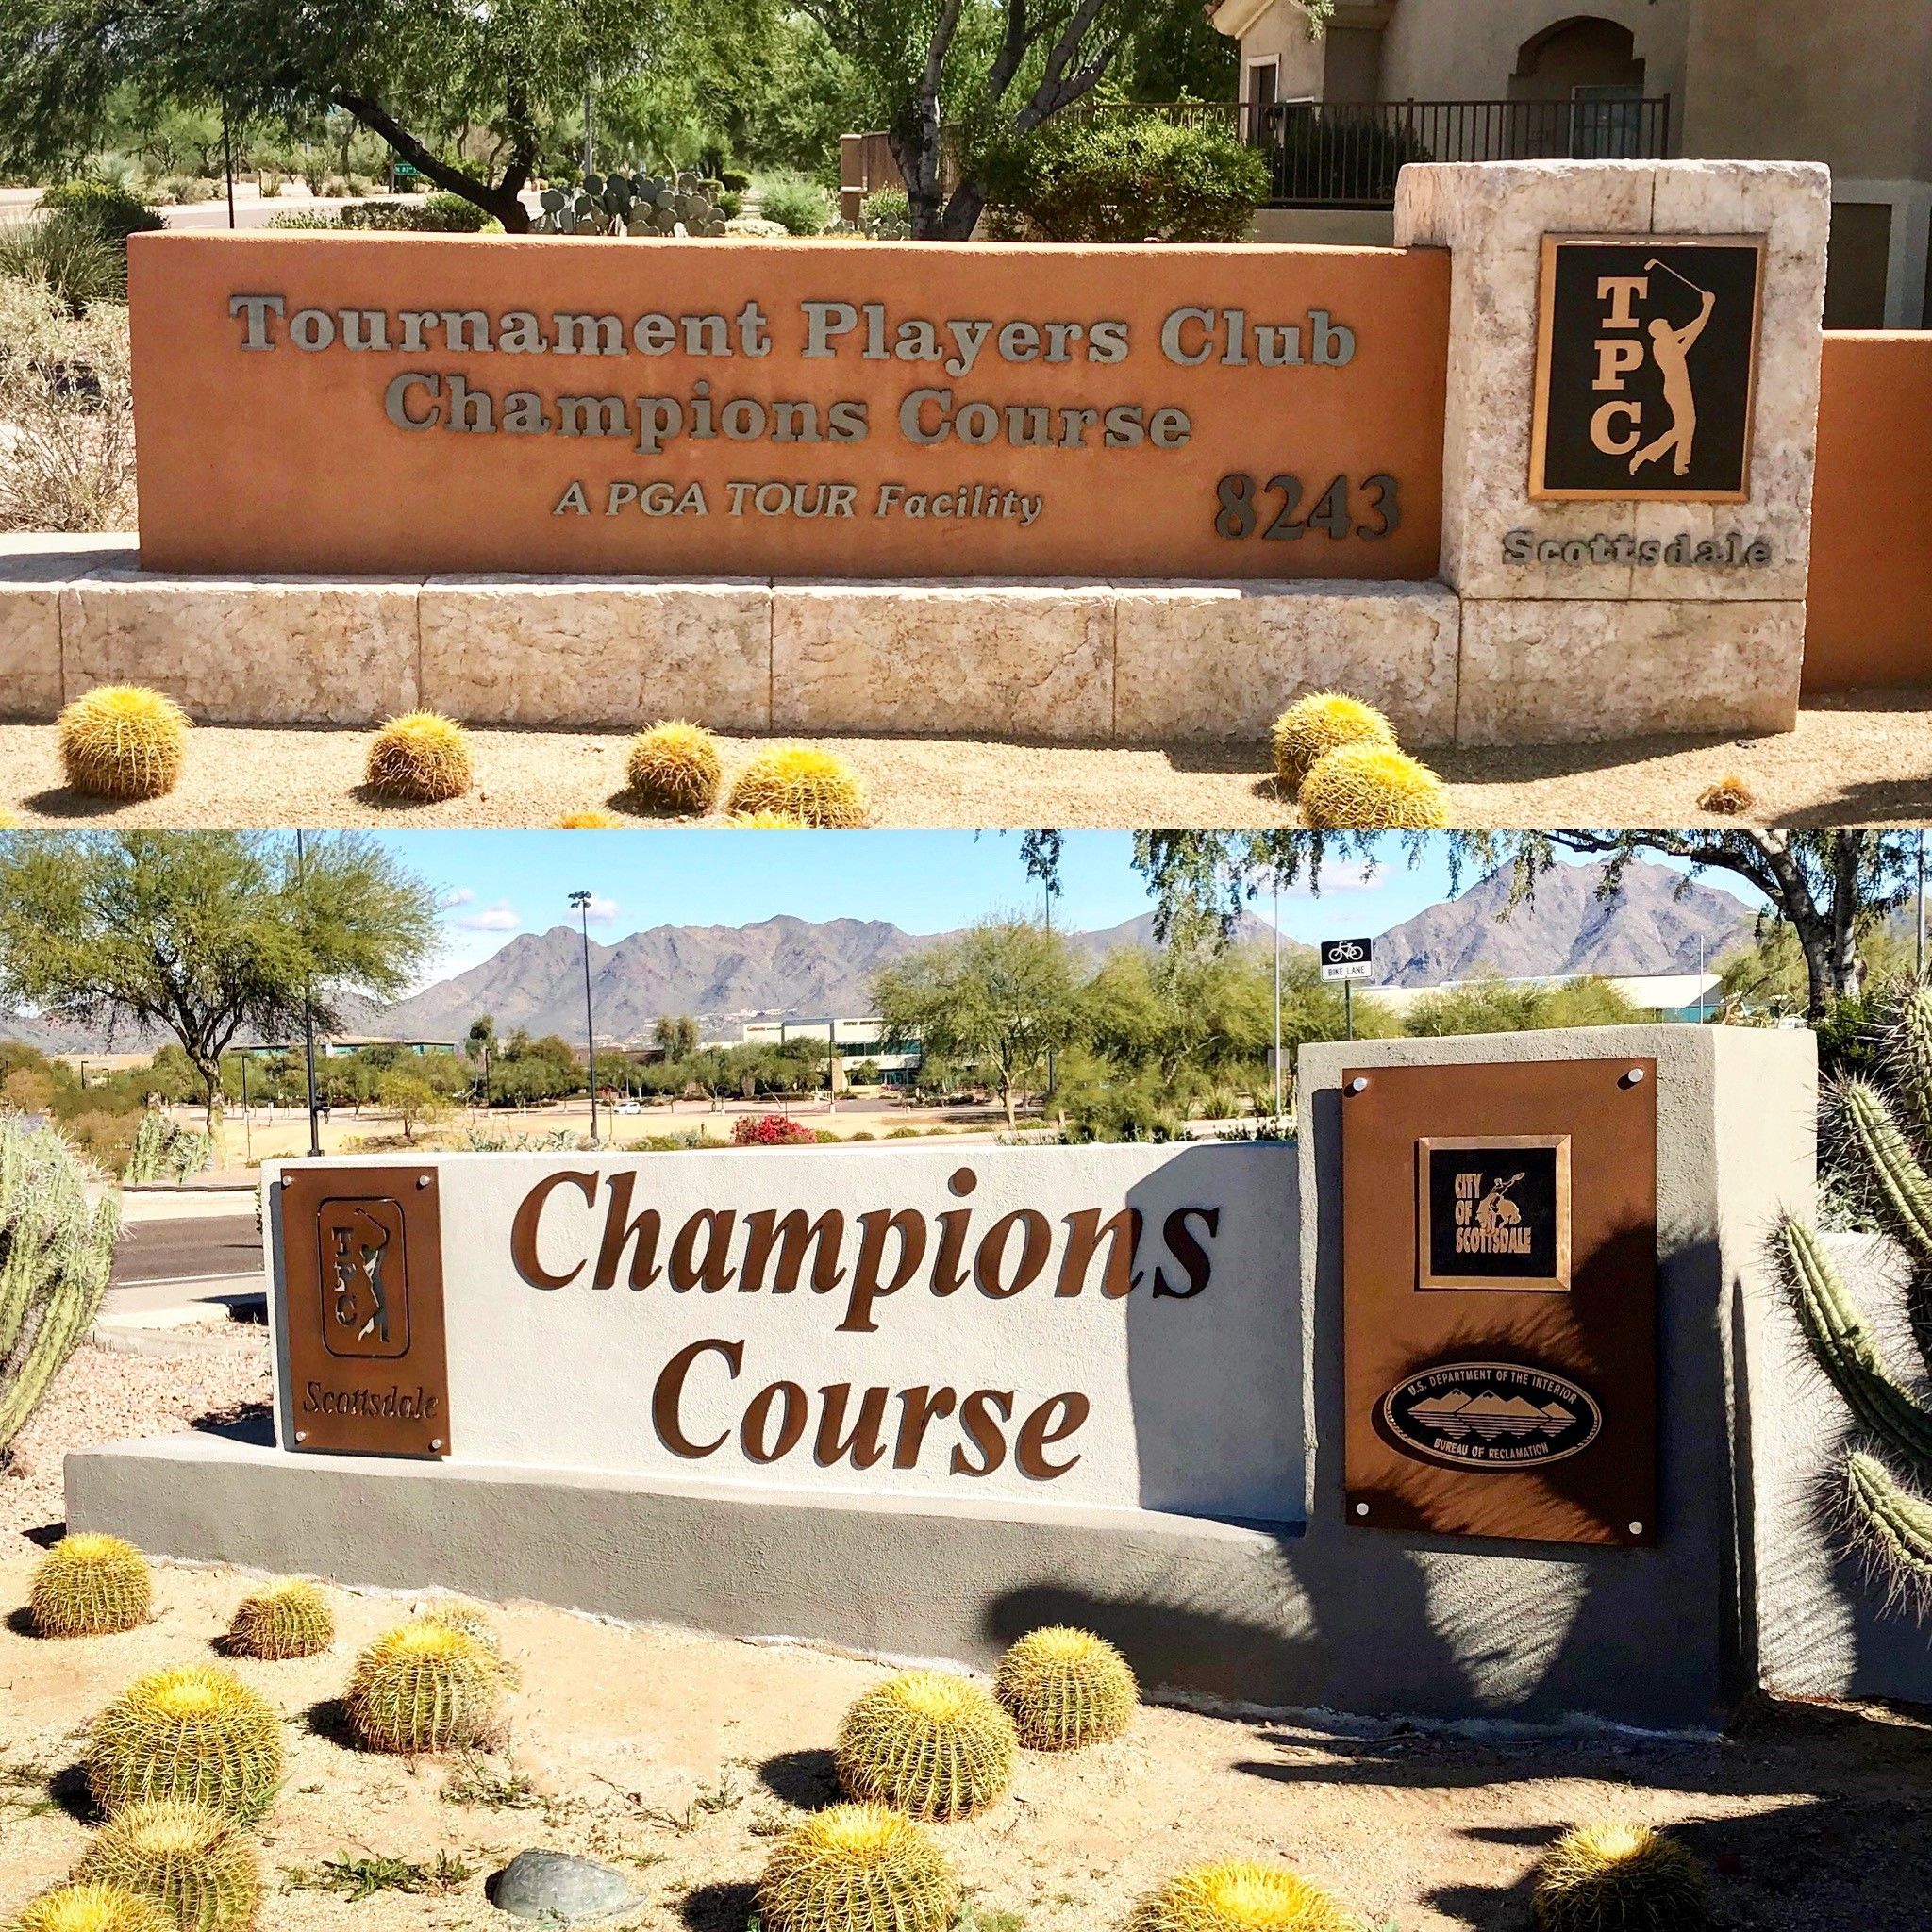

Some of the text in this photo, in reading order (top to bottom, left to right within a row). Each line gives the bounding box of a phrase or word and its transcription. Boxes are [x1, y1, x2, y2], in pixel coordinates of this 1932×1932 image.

[229, 294, 1356, 377] Tournament Players Club
[1590, 276, 1649, 455] TPC
[385, 372, 1191, 455] Champions Course
[553, 480, 1043, 527] A PGA TOUR Facility
[1213, 472, 1401, 541] 8243
[1502, 530, 1773, 568] Scottsdale
[1327, 966, 1365, 976] BIKE LANE
[1455, 1173, 1483, 1199] CITY
[1455, 1200, 1473, 1225] OF
[510, 1167, 1222, 1332] Champions
[1456, 1227, 1532, 1254] SCOTTSDALE
[302, 1380, 439, 1419] Scottsdale
[1407, 1369, 1578, 1405] U.S. DEPARTMENT OF THE INTERIOR
[651, 1338, 1091, 1481] Course
[1433, 1438, 1549, 1460] BUREAU OF RECLAMATION
